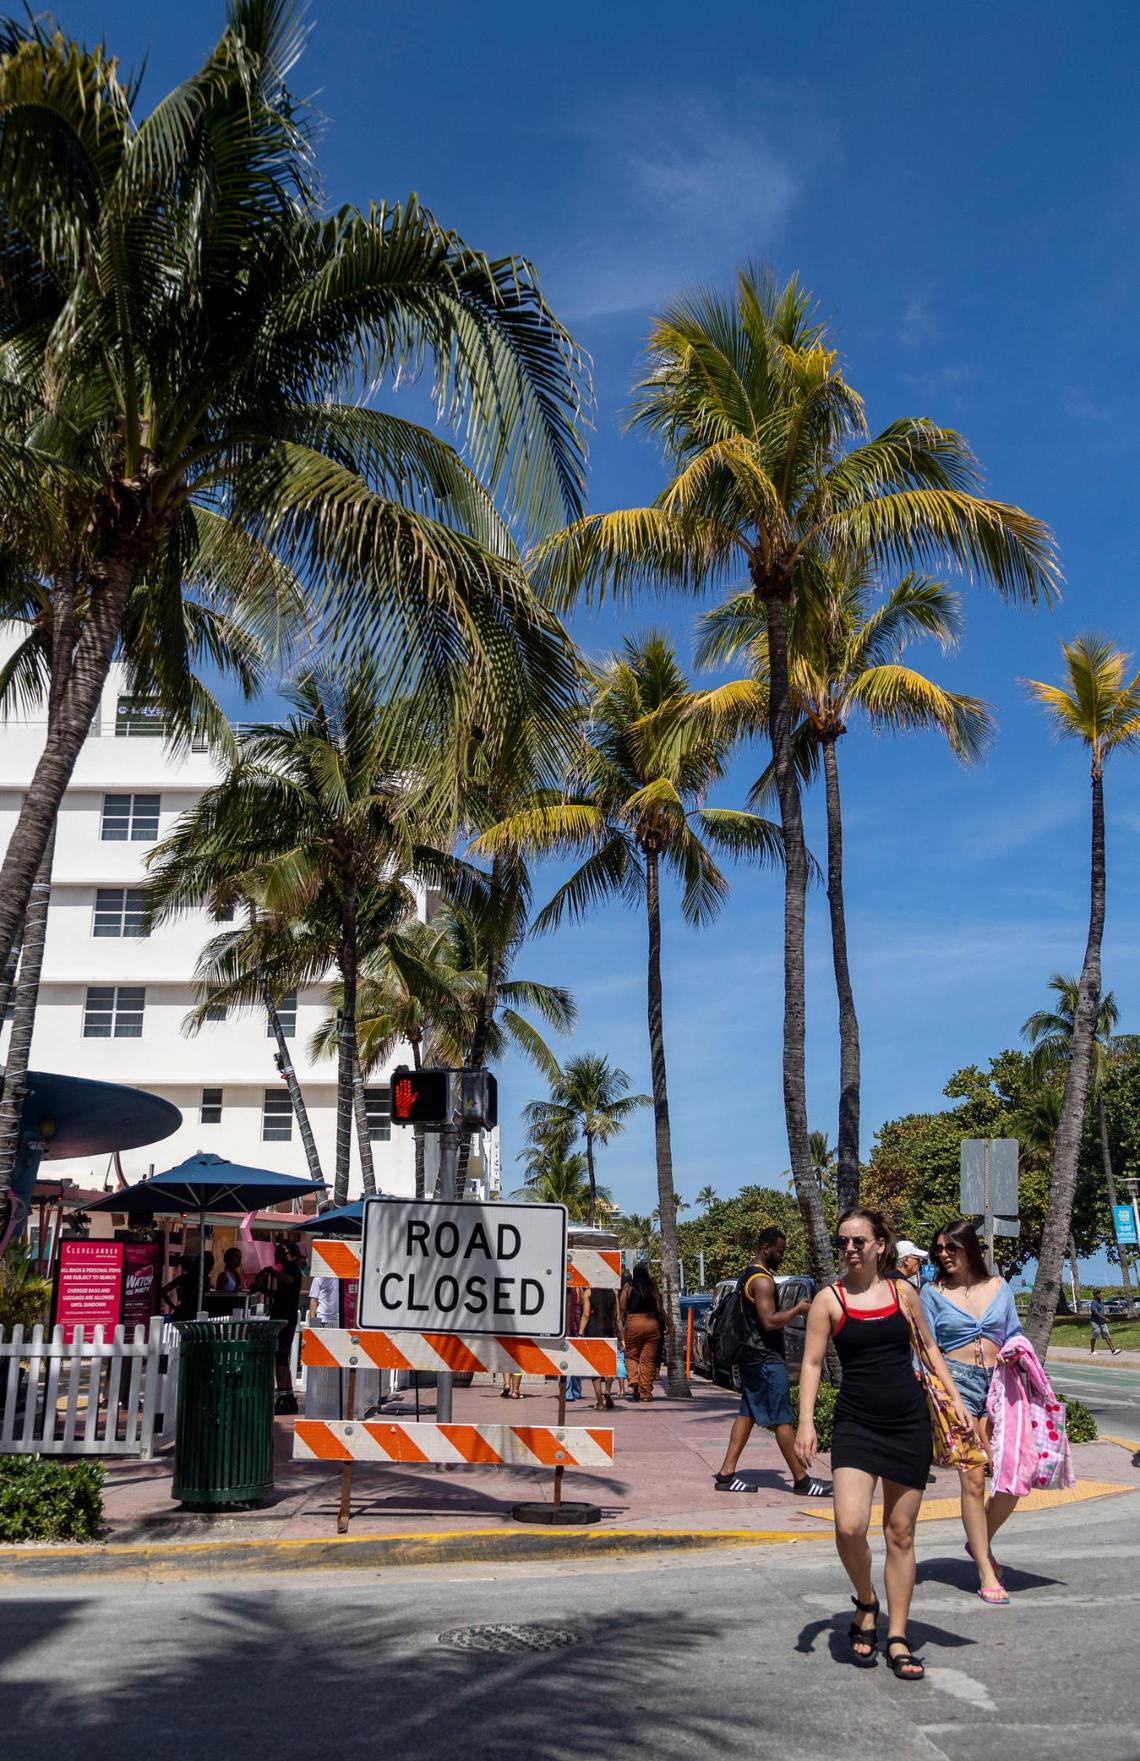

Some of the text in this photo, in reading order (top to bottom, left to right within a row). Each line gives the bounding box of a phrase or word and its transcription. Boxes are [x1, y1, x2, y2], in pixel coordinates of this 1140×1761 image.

[66, 1245, 118, 1254] CLEVELANDER
[406, 1220, 521, 1260] ROAD
[126, 1274, 154, 1289] WATCH
[379, 1272, 545, 1315] CLOSED
